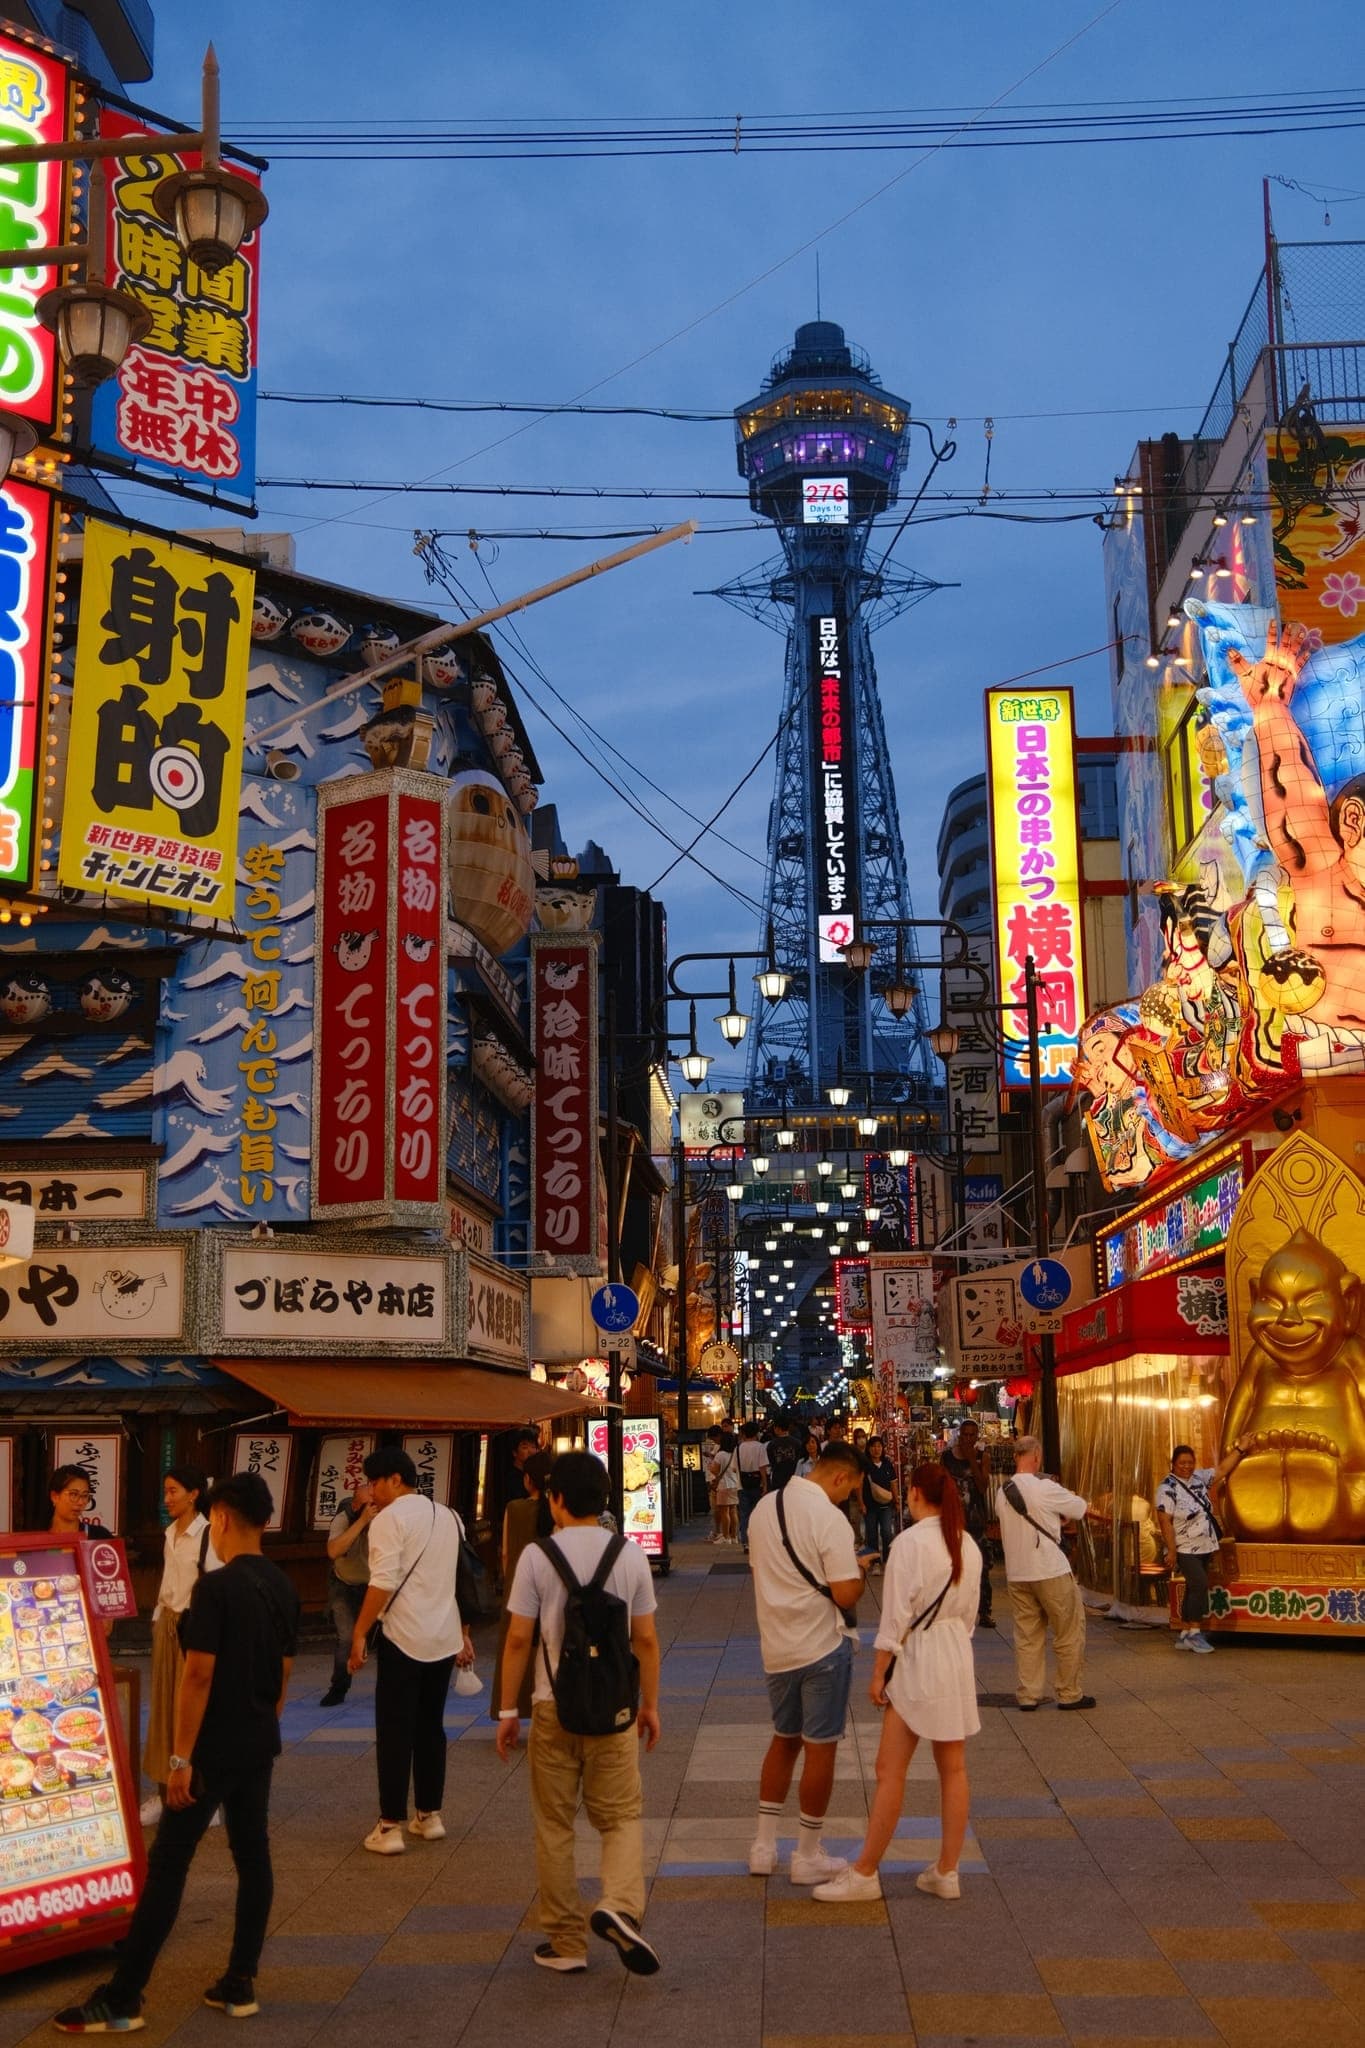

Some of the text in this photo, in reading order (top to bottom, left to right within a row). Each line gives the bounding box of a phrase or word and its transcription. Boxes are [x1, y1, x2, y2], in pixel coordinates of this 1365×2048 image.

[121, 358, 236, 422] 年中
[121, 403, 238, 478] 無休
[806, 484, 846, 502] 276
[90, 547, 240, 838] 射的
[999, 698, 1060, 722] 新世界
[819, 617, 847, 911] 日立は「未来の都市」に協賛しています
[1015, 725, 1056, 900] 日本一の串かつ
[87, 824, 223, 871] 新世界遊技場
[337, 819, 378, 915] 名物
[401, 818, 438, 913] 名物
[82, 853, 225, 903] チャンピオン
[1006, 904, 1078, 1037] 横綱
[238, 842, 285, 1206] 安うて何んでも旨い
[334, 983, 374, 1182] てっちり
[399, 982, 435, 1181] てっちり
[542, 998, 583, 1246] 珍味てっちり
[0, 1265, 79, 1326] や
[234, 1279, 436, 1320] づぼらや本店
[1180, 1278, 1225, 1289] 日本一の
[600, 1338, 630, 1348] 9-22
[1029, 1319, 1061, 1331] 9-22
[263, 1440, 281, 1473] ふぐ
[343, 1439, 366, 1491] おみやげ
[319, 1465, 339, 1517] ふぐ料理
[1203, 1588, 1326, 1618] 本一の串かつ
[1328, 1589, 1365, 1622] 横
[12, 1871, 133, 1925] 06-6630-8440
